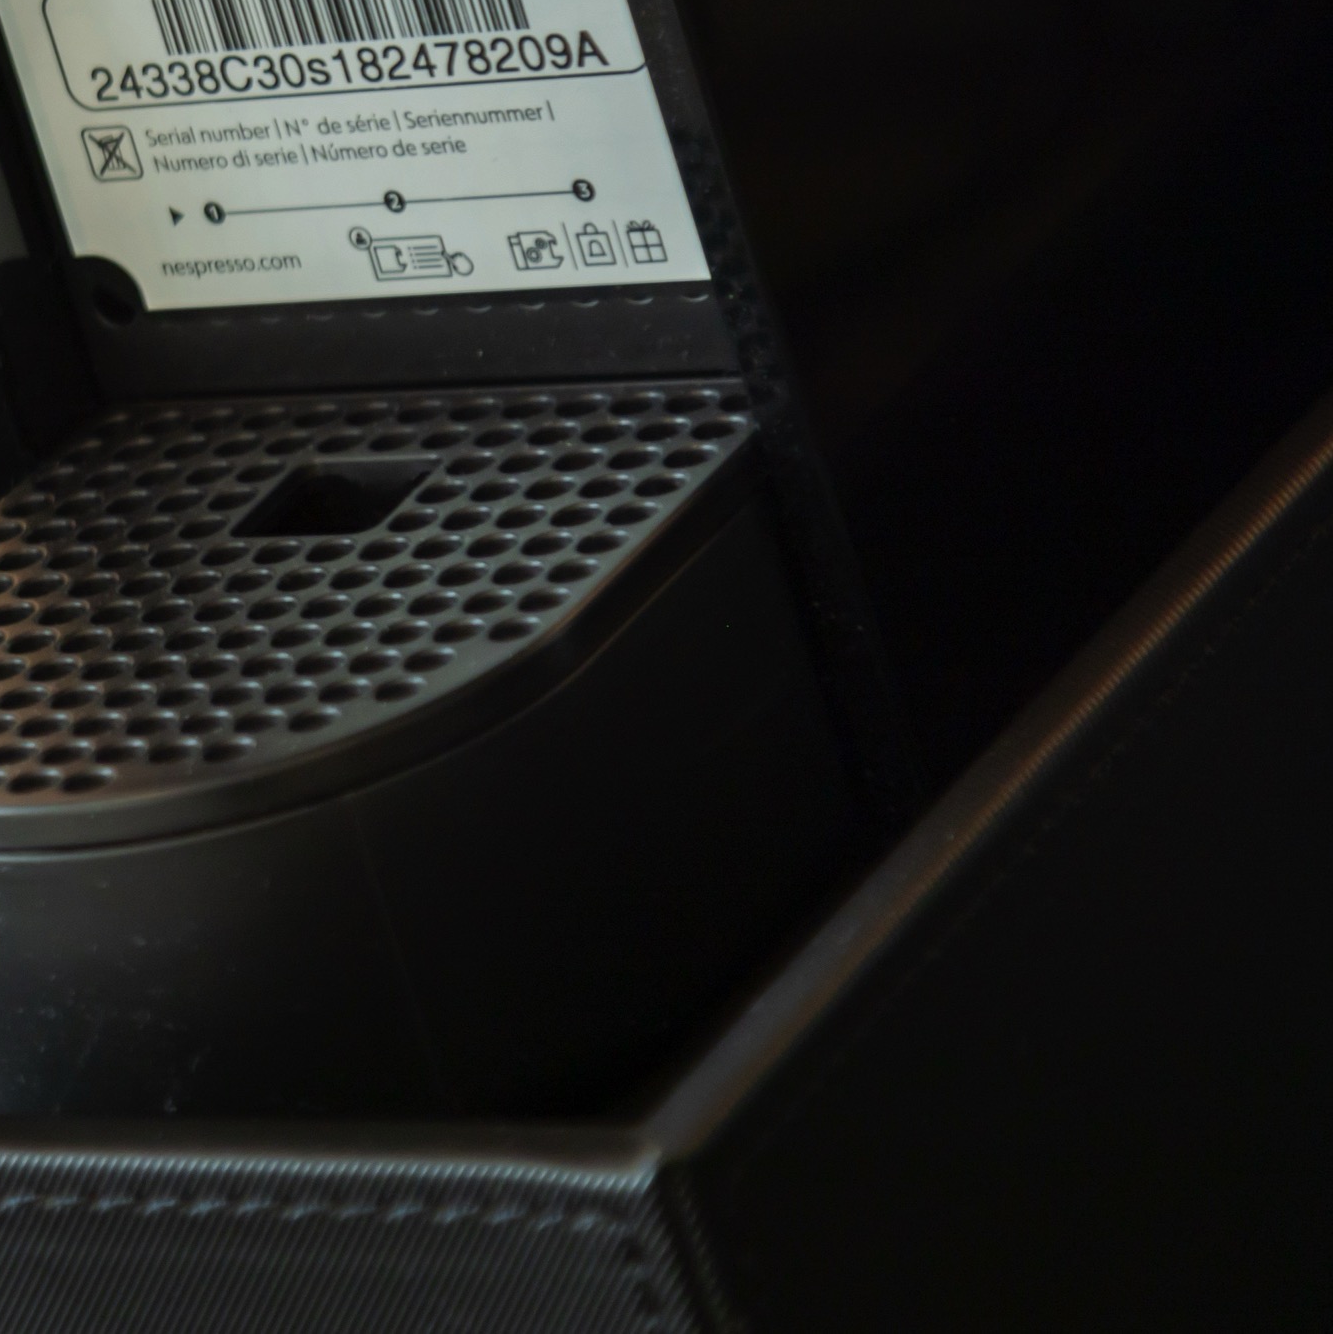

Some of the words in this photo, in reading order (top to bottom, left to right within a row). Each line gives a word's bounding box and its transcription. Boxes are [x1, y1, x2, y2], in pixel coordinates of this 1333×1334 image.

[90, 29, 610, 103] 24338C30s182478209A
[145, 127, 196, 148] Serial
[200, 123, 271, 144] number
[317, 116, 343, 136] de
[346, 112, 391, 134] série
[404, 105, 543, 130] Seriennummer
[152, 155, 229, 175] Numero
[232, 148, 251, 169] di
[254, 146, 299, 167] serie
[311, 141, 389, 163] Número
[392, 138, 418, 159] de
[421, 135, 468, 156] serie
[162, 252, 302, 277] nespresso.com
